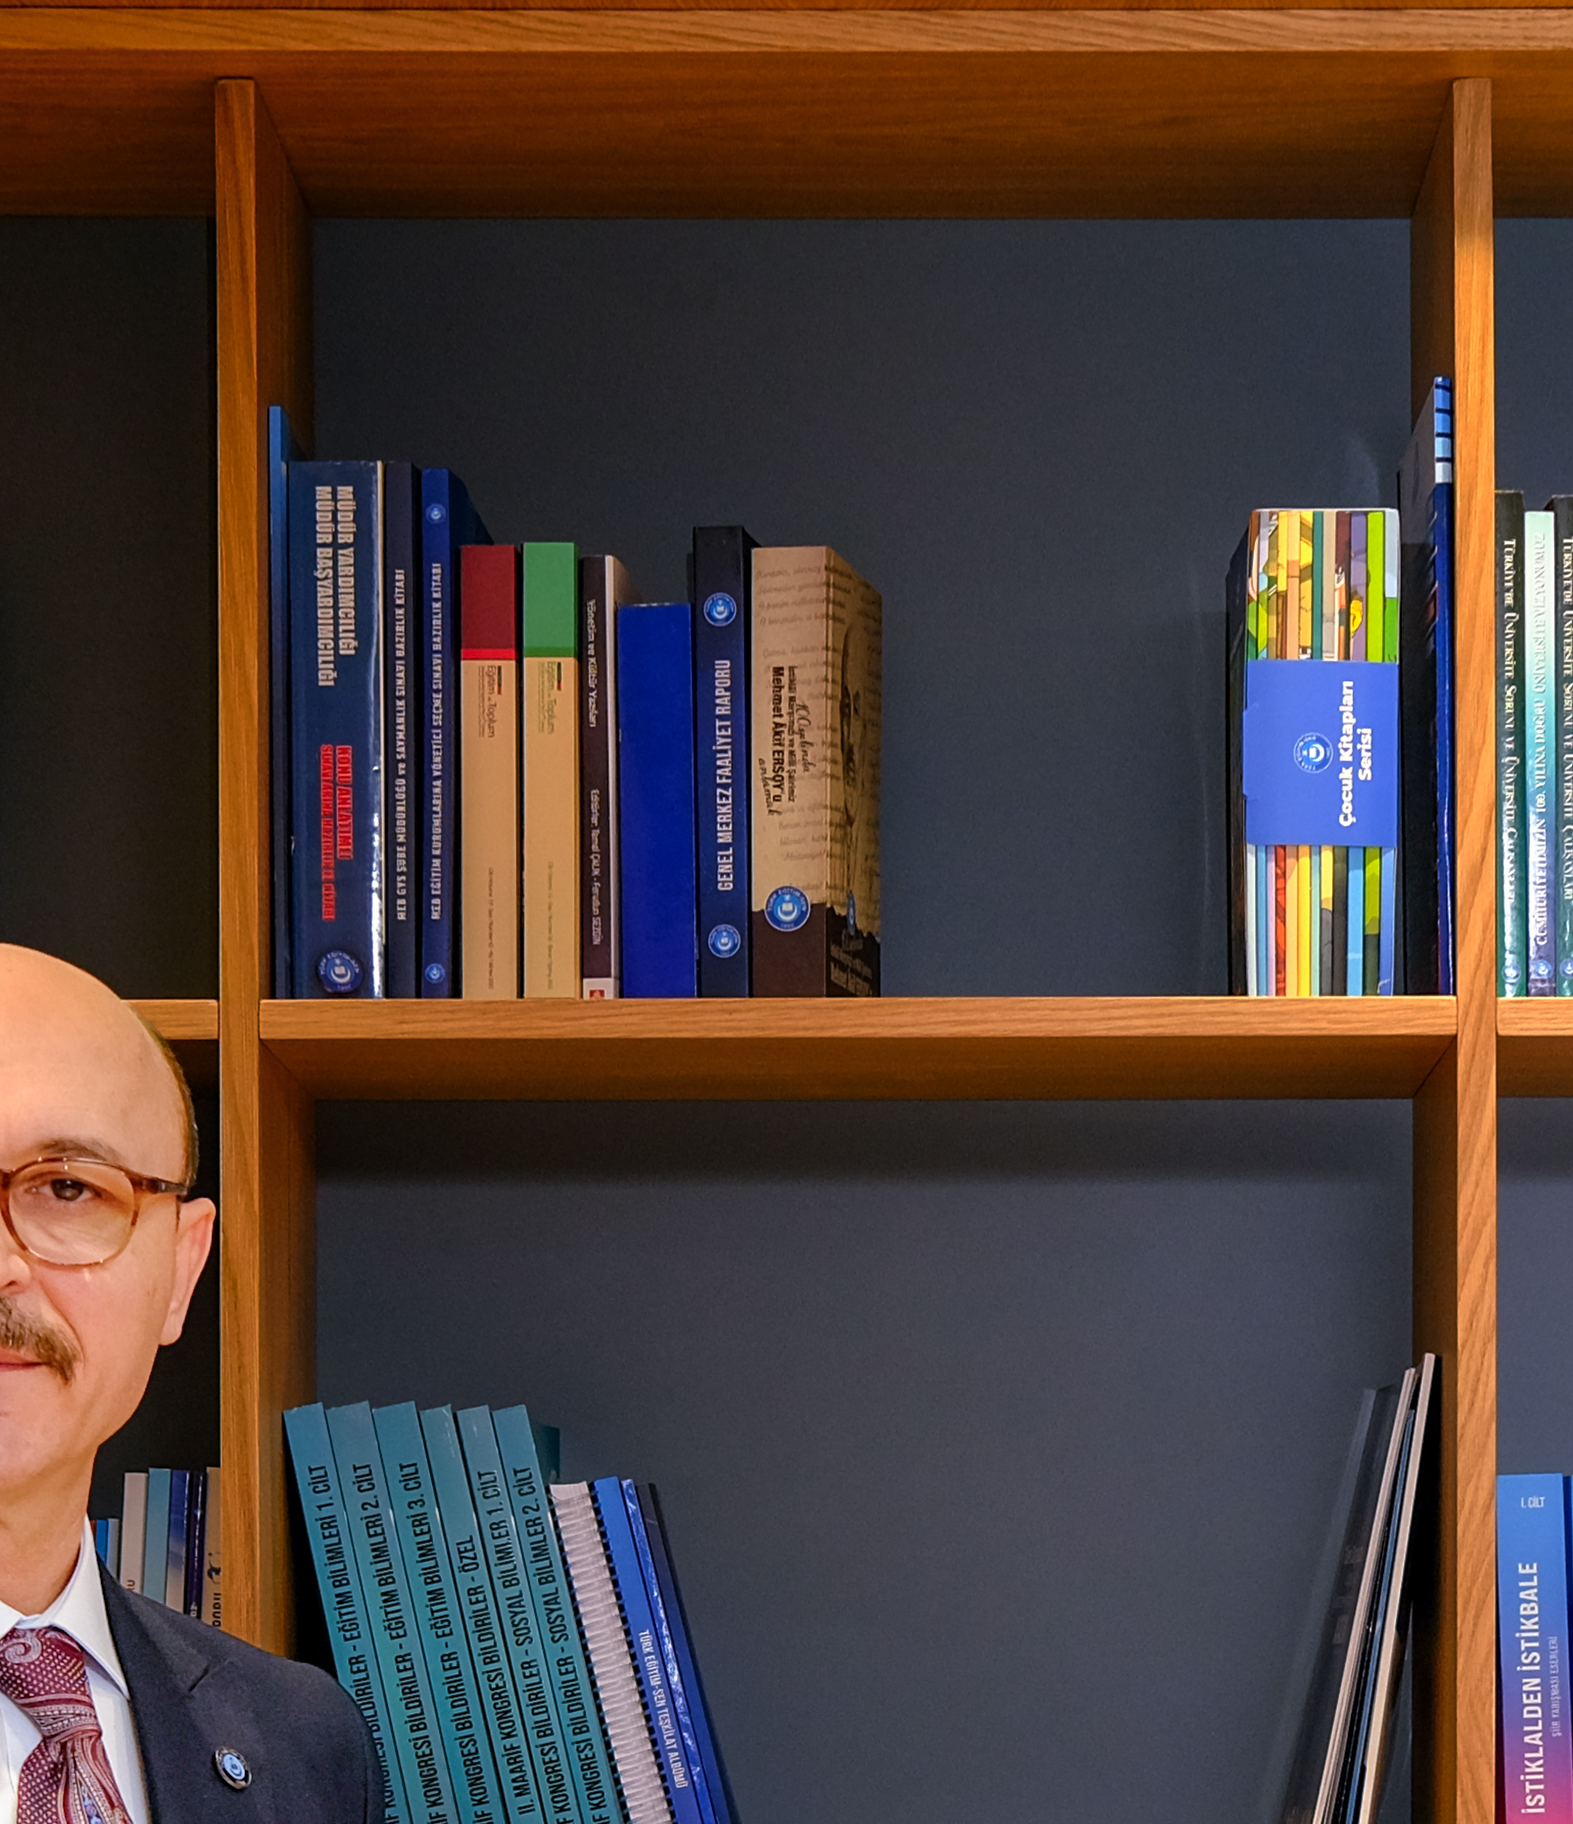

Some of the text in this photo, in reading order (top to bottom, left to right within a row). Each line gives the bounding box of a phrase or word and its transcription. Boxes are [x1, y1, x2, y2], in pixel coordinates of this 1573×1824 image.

[314, 487, 337, 687] MÜDÜR BAŞYARDIMCILIĞI
[337, 487, 358, 655] MÜDÜR YARDIMCILIĞI
[772, 667, 784, 718] Mehmet
[430, 563, 443, 919] MEB EĞİTİM KURUMLARINA YÖNETİCİ SEÇME SINAVI HAZIRLIK KİTABI
[712, 659, 733, 891] GENEL MERKEZ FAALİYET RAPORU
[772, 750, 785, 802] ERSOY'u
[1338, 681, 1356, 827] Çocuk Kitapları
[1357, 728, 1372, 780] Serisi
[336, 746, 353, 859] KONU ANLATIMLI
[399, 1463, 421, 1491] CİLT
[407, 1494, 425, 1509] 3.
[406, 1512, 442, 1586] BİLİMLERİ
[477, 1471, 533, 1646] SOSYAL BİLİMLER 1. CİLT
[425, 1588, 453, 1639] EĞİTİM
[441, 1651, 473, 1731] BİLDİRİLER
[638, 1629, 688, 1788] TÜRK EĞİTİM-SEN TEŞKİLAT ALBÜMÜ
[1515, 1563, 1545, 1814] İSTİKLALDEN İSTİKBALE
[454, 1733, 489, 1806] KONGRESİ
